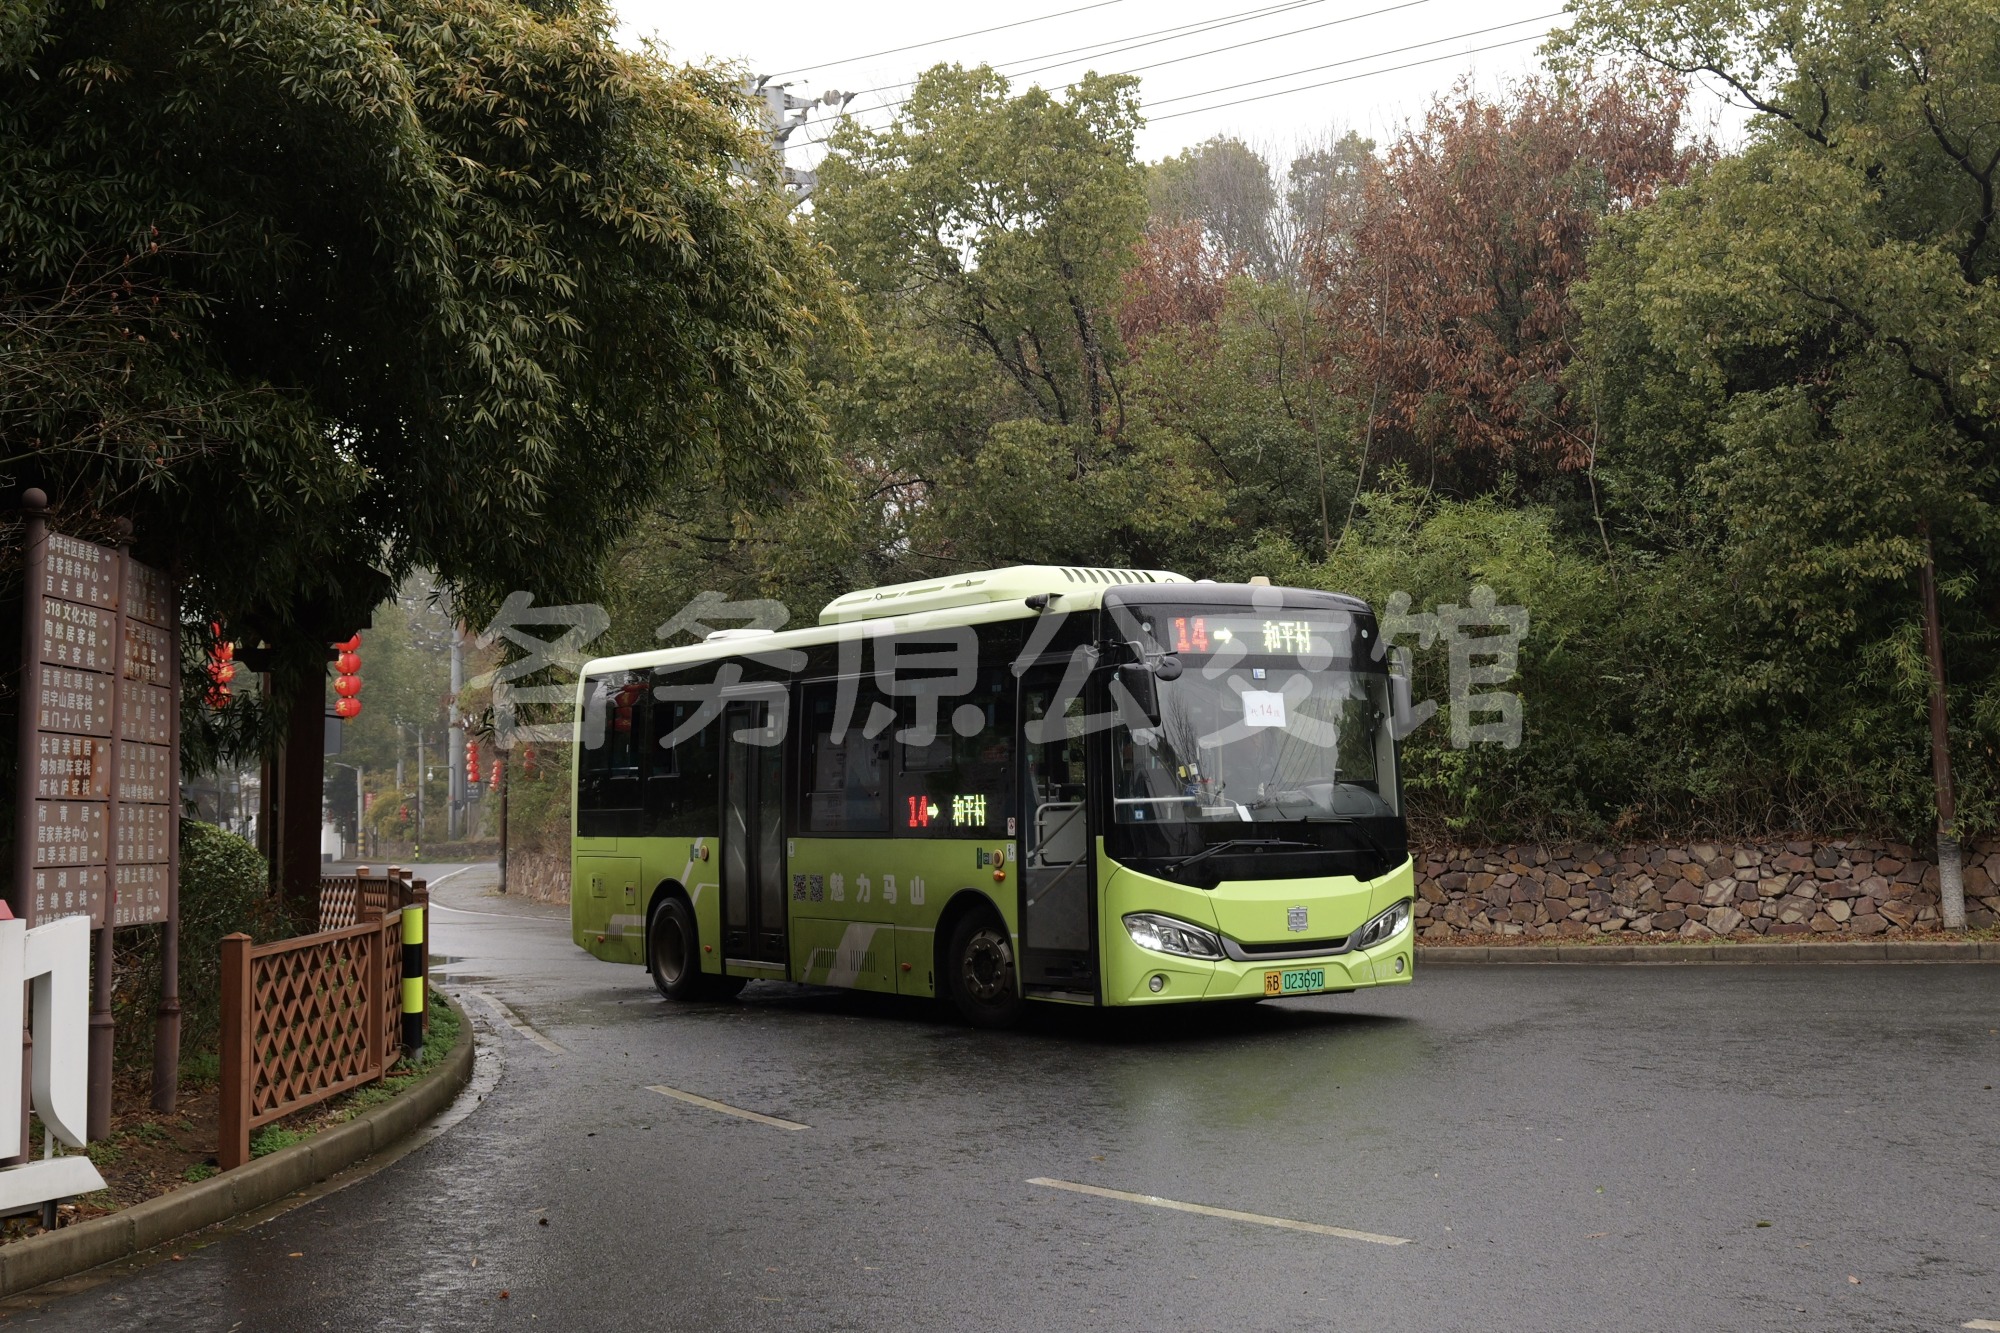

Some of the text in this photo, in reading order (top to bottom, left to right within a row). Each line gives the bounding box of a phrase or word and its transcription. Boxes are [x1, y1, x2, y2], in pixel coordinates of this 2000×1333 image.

[48, 535, 99, 562] 和平社区居委会
[47, 555, 98, 582] 游客接待中心
[46, 576, 98, 602] 百年银杏
[44, 620, 96, 647] 陶然居客栈
[1175, 617, 1311, 653] 14 和平村
[44, 640, 95, 667] 平安客栈
[41, 710, 92, 730] 雁门十八号
[40, 737, 92, 755] 长留幸福居
[40, 758, 91, 775] 匆匆那年客栈
[120, 762, 155, 780] 山里人家
[40, 779, 90, 796] 听松庐客栈
[119, 808, 155, 823] 万和农庄
[908, 794, 986, 827] 14 和平村
[38, 826, 88, 842] 居家养老中心
[118, 826, 154, 842] 湾农庄
[37, 846, 88, 863] 四季采摘园
[829, 872, 925, 905] 魅力马山
[36, 890, 87, 911] 佳缘客栈
[116, 906, 153, 923] 宜佳人客栈
